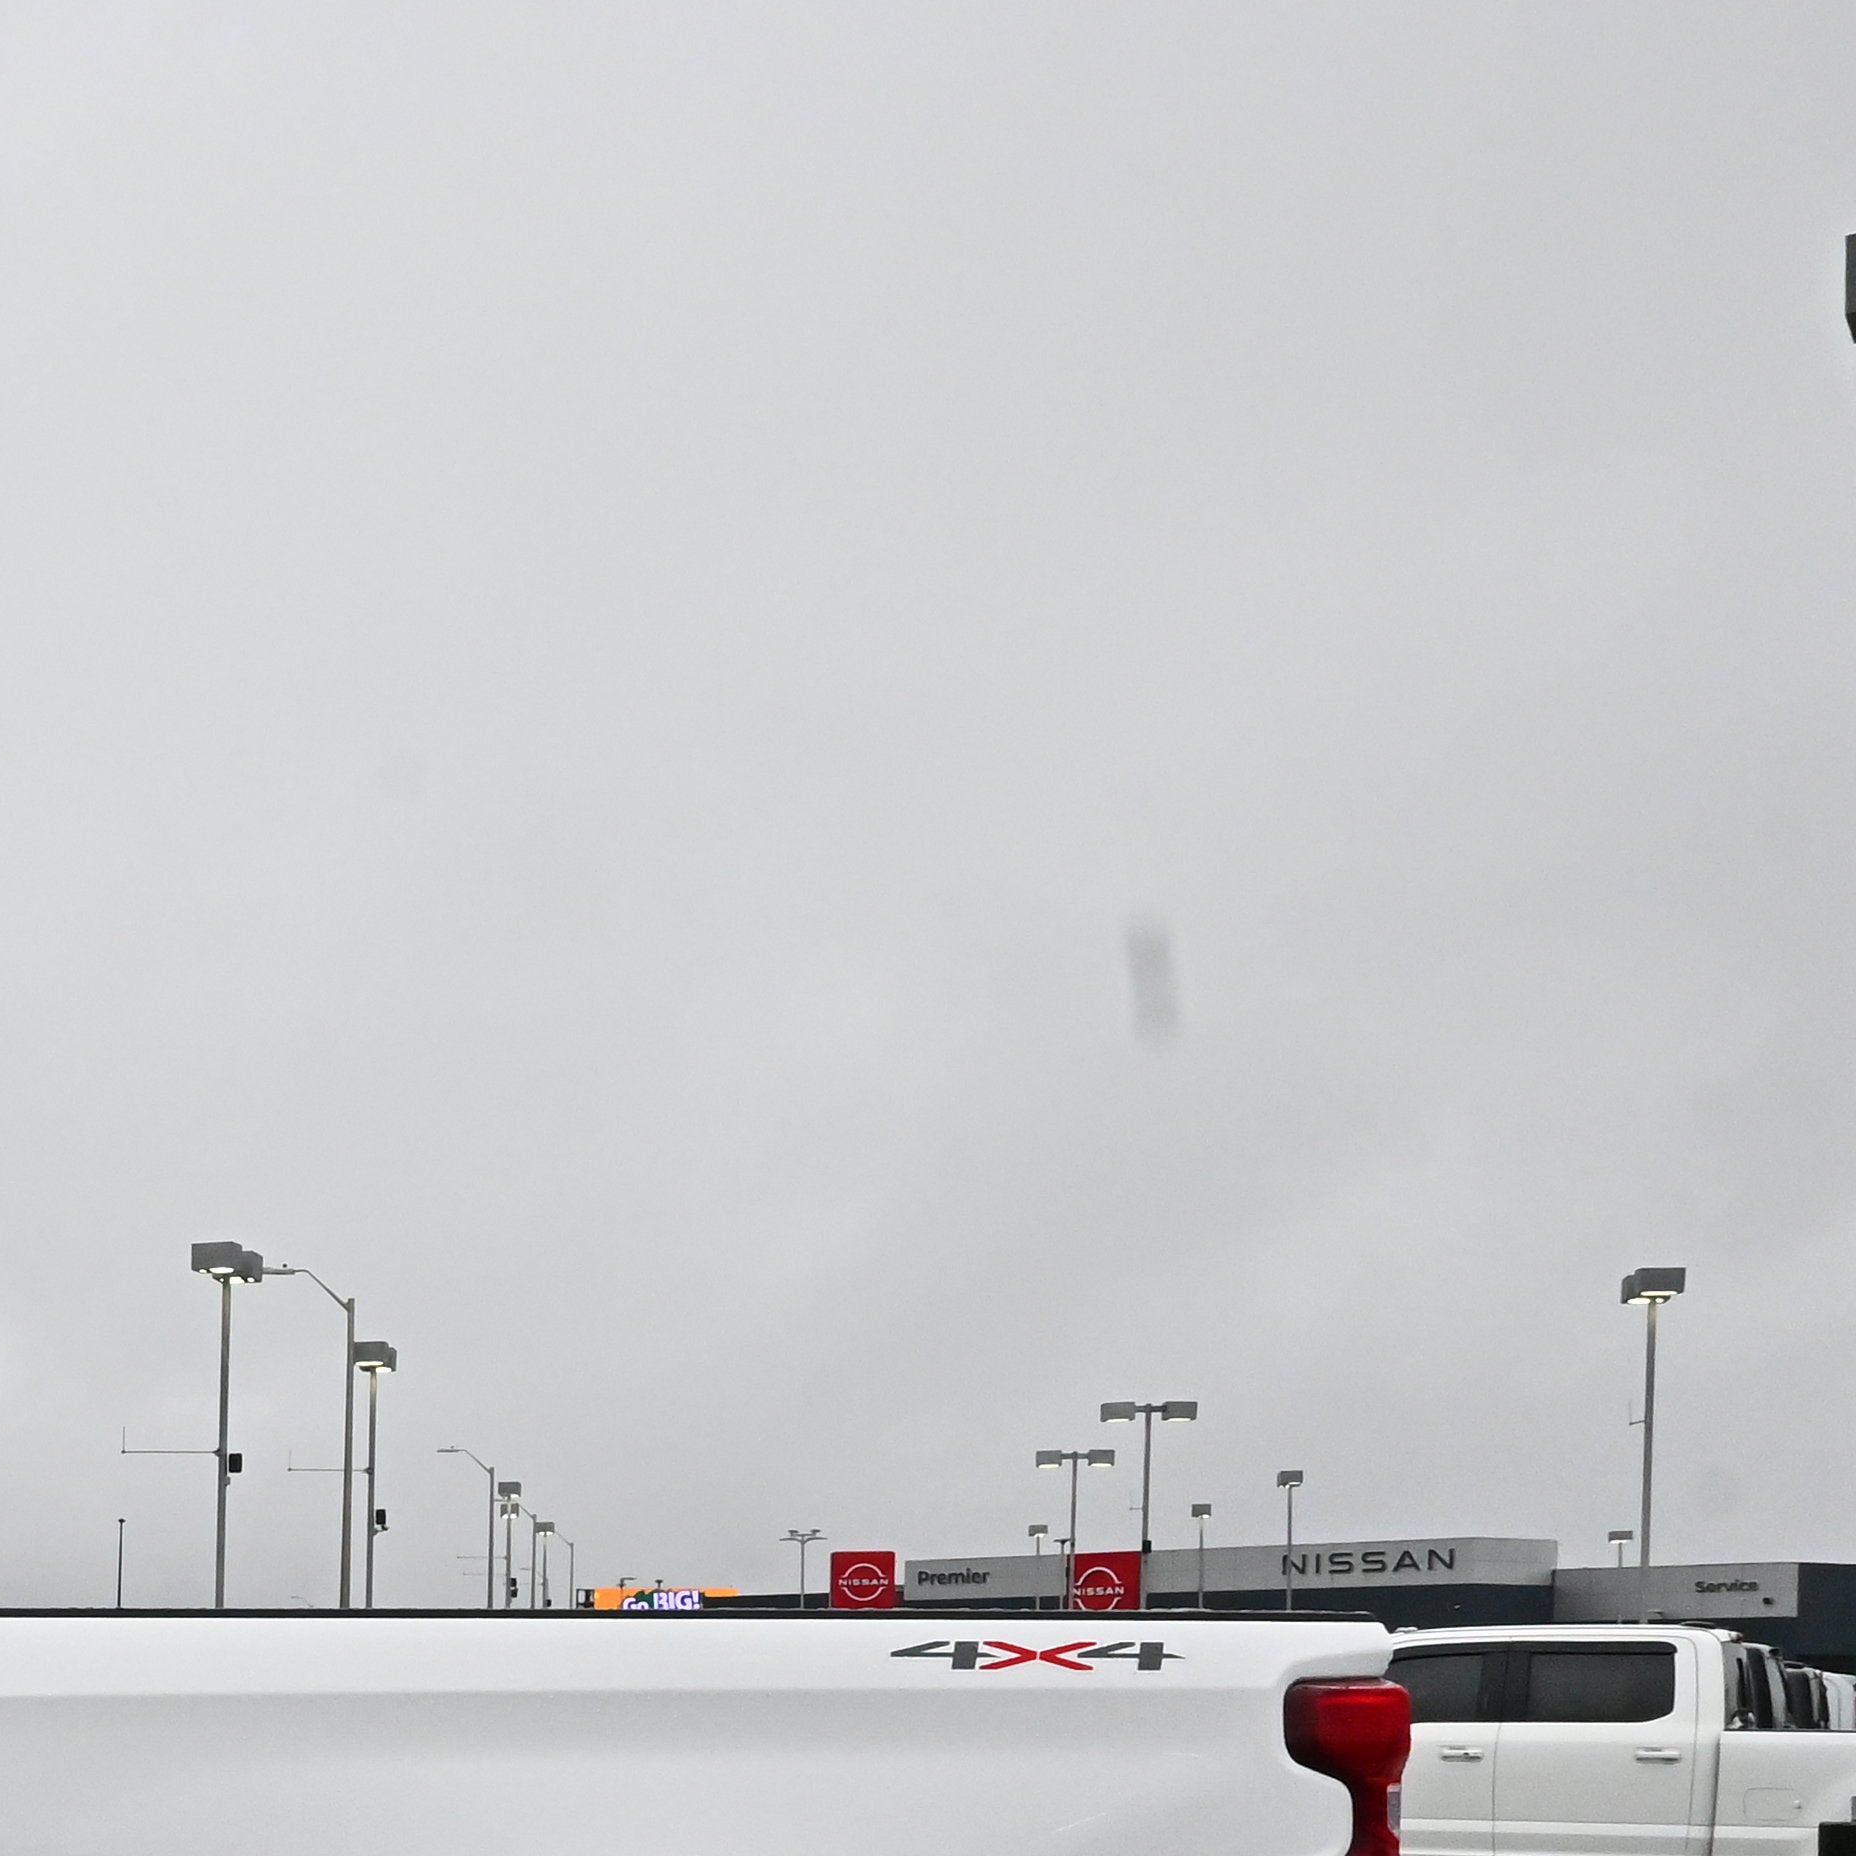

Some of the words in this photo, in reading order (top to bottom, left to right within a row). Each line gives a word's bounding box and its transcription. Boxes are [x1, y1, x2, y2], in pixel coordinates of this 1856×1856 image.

[1281, 1548, 1456, 1575] NISSAN
[838, 1577, 889, 1587] NISSAN
[917, 1567, 991, 1586] Premier
[1073, 1586, 1125, 1597] NISSAN
[1694, 1578, 1760, 1594] Service
[652, 1590, 701, 1610] BIG!
